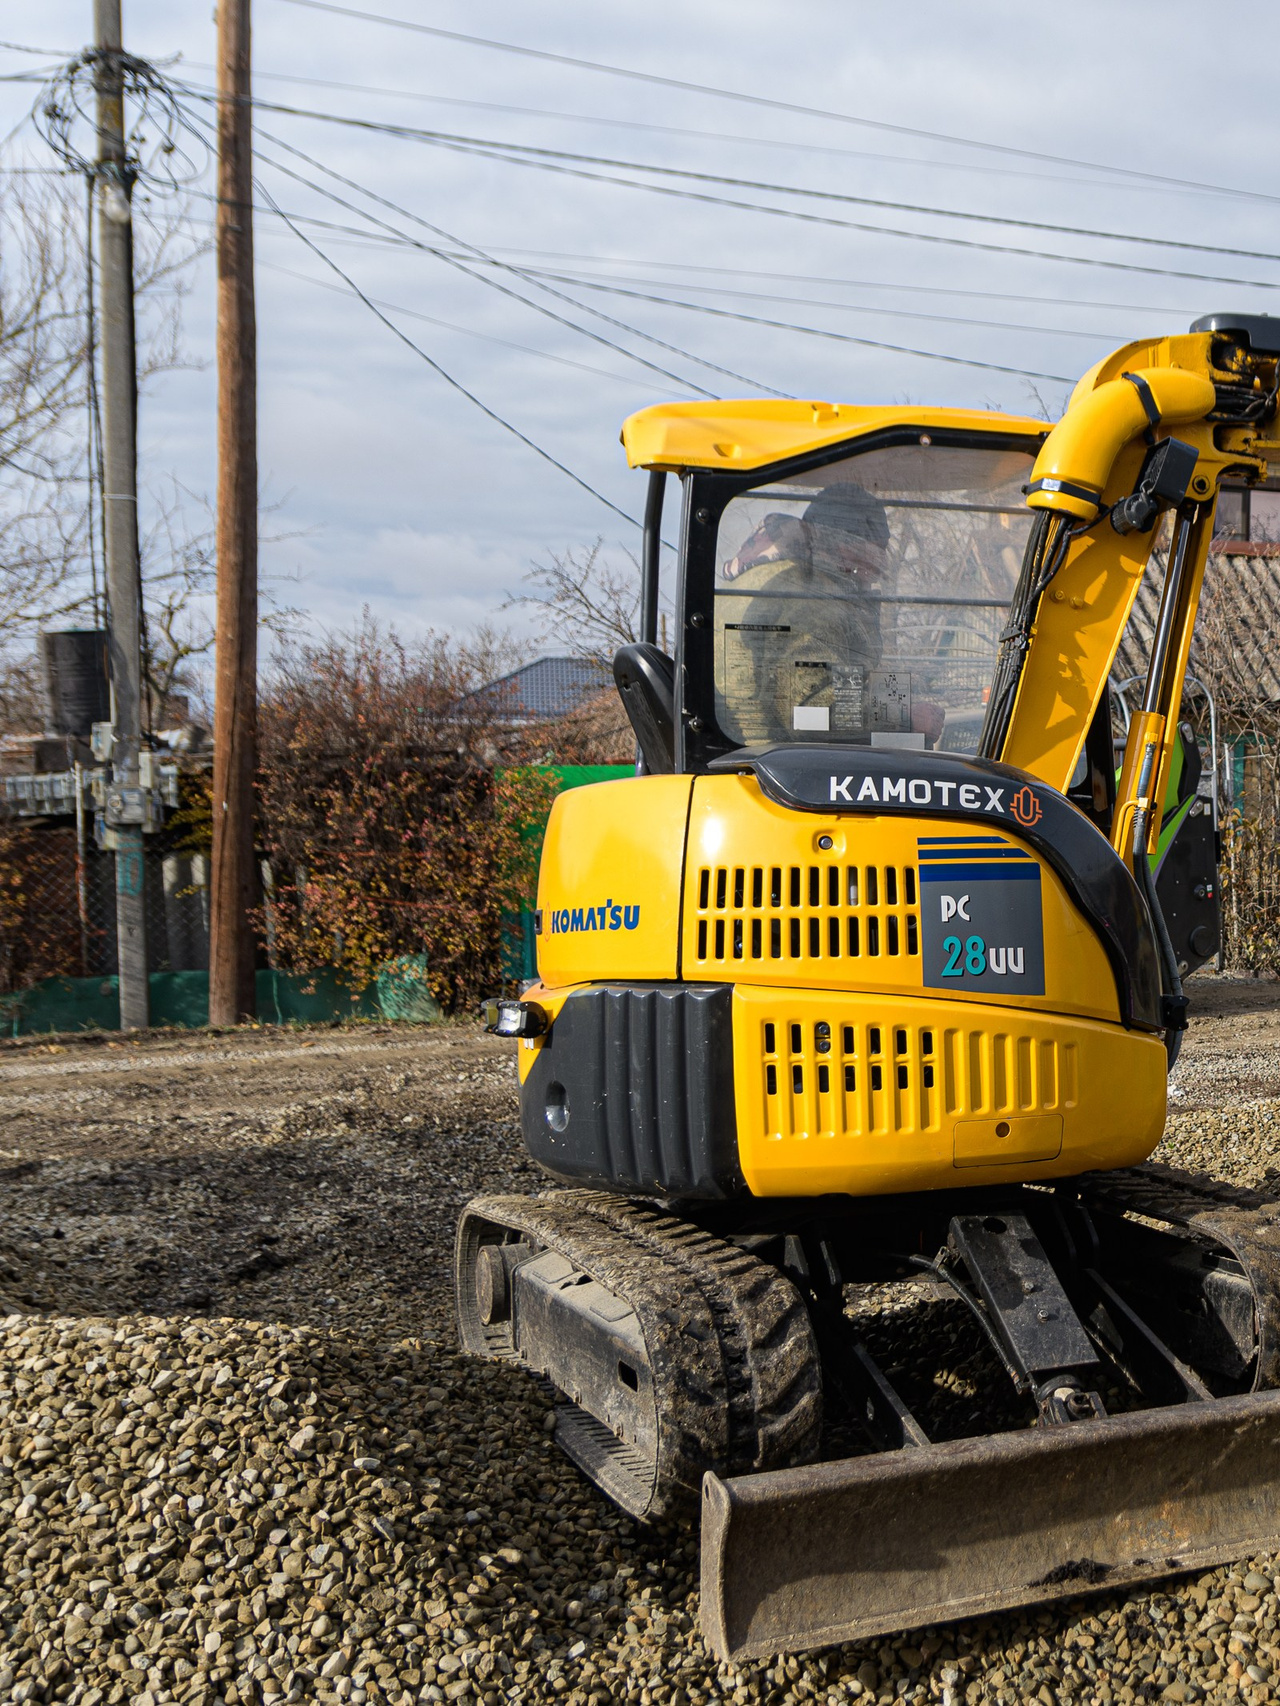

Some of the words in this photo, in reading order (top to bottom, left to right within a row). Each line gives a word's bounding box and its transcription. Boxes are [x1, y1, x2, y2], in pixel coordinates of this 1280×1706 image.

[830, 776, 1005, 813] KAMOTEX
[551, 899, 640, 934] KOMATSU
[940, 894, 971, 922] PC
